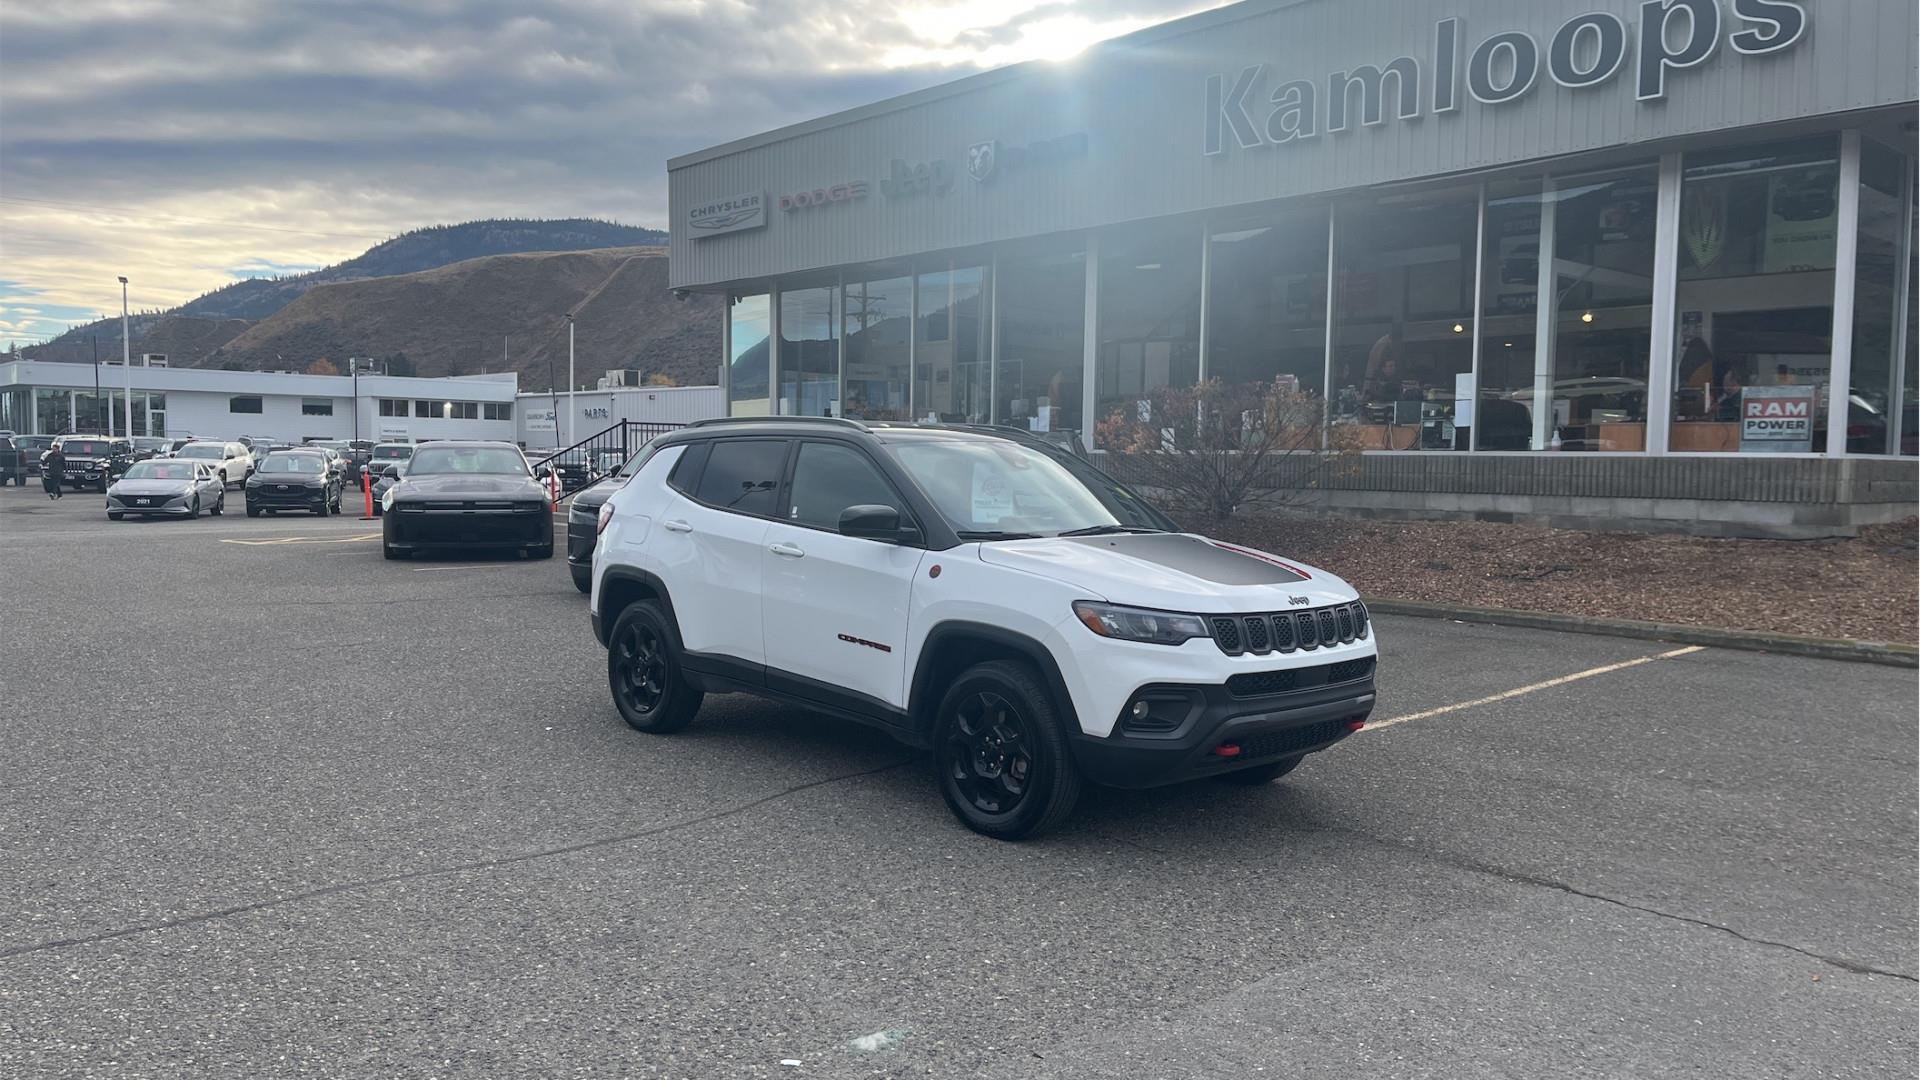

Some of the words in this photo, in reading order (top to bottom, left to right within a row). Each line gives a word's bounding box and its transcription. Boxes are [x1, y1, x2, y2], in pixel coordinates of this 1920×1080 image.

[1204, 0, 1806, 156] Kamloops
[779, 180, 868, 212] DODGE
[690, 196, 759, 218] CHRYSLER
[585, 408, 607, 419] PARTS
[1747, 402, 1808, 416] RAM
[1747, 420, 1805, 430] POWER
[1288, 595, 1310, 606] Jeep
